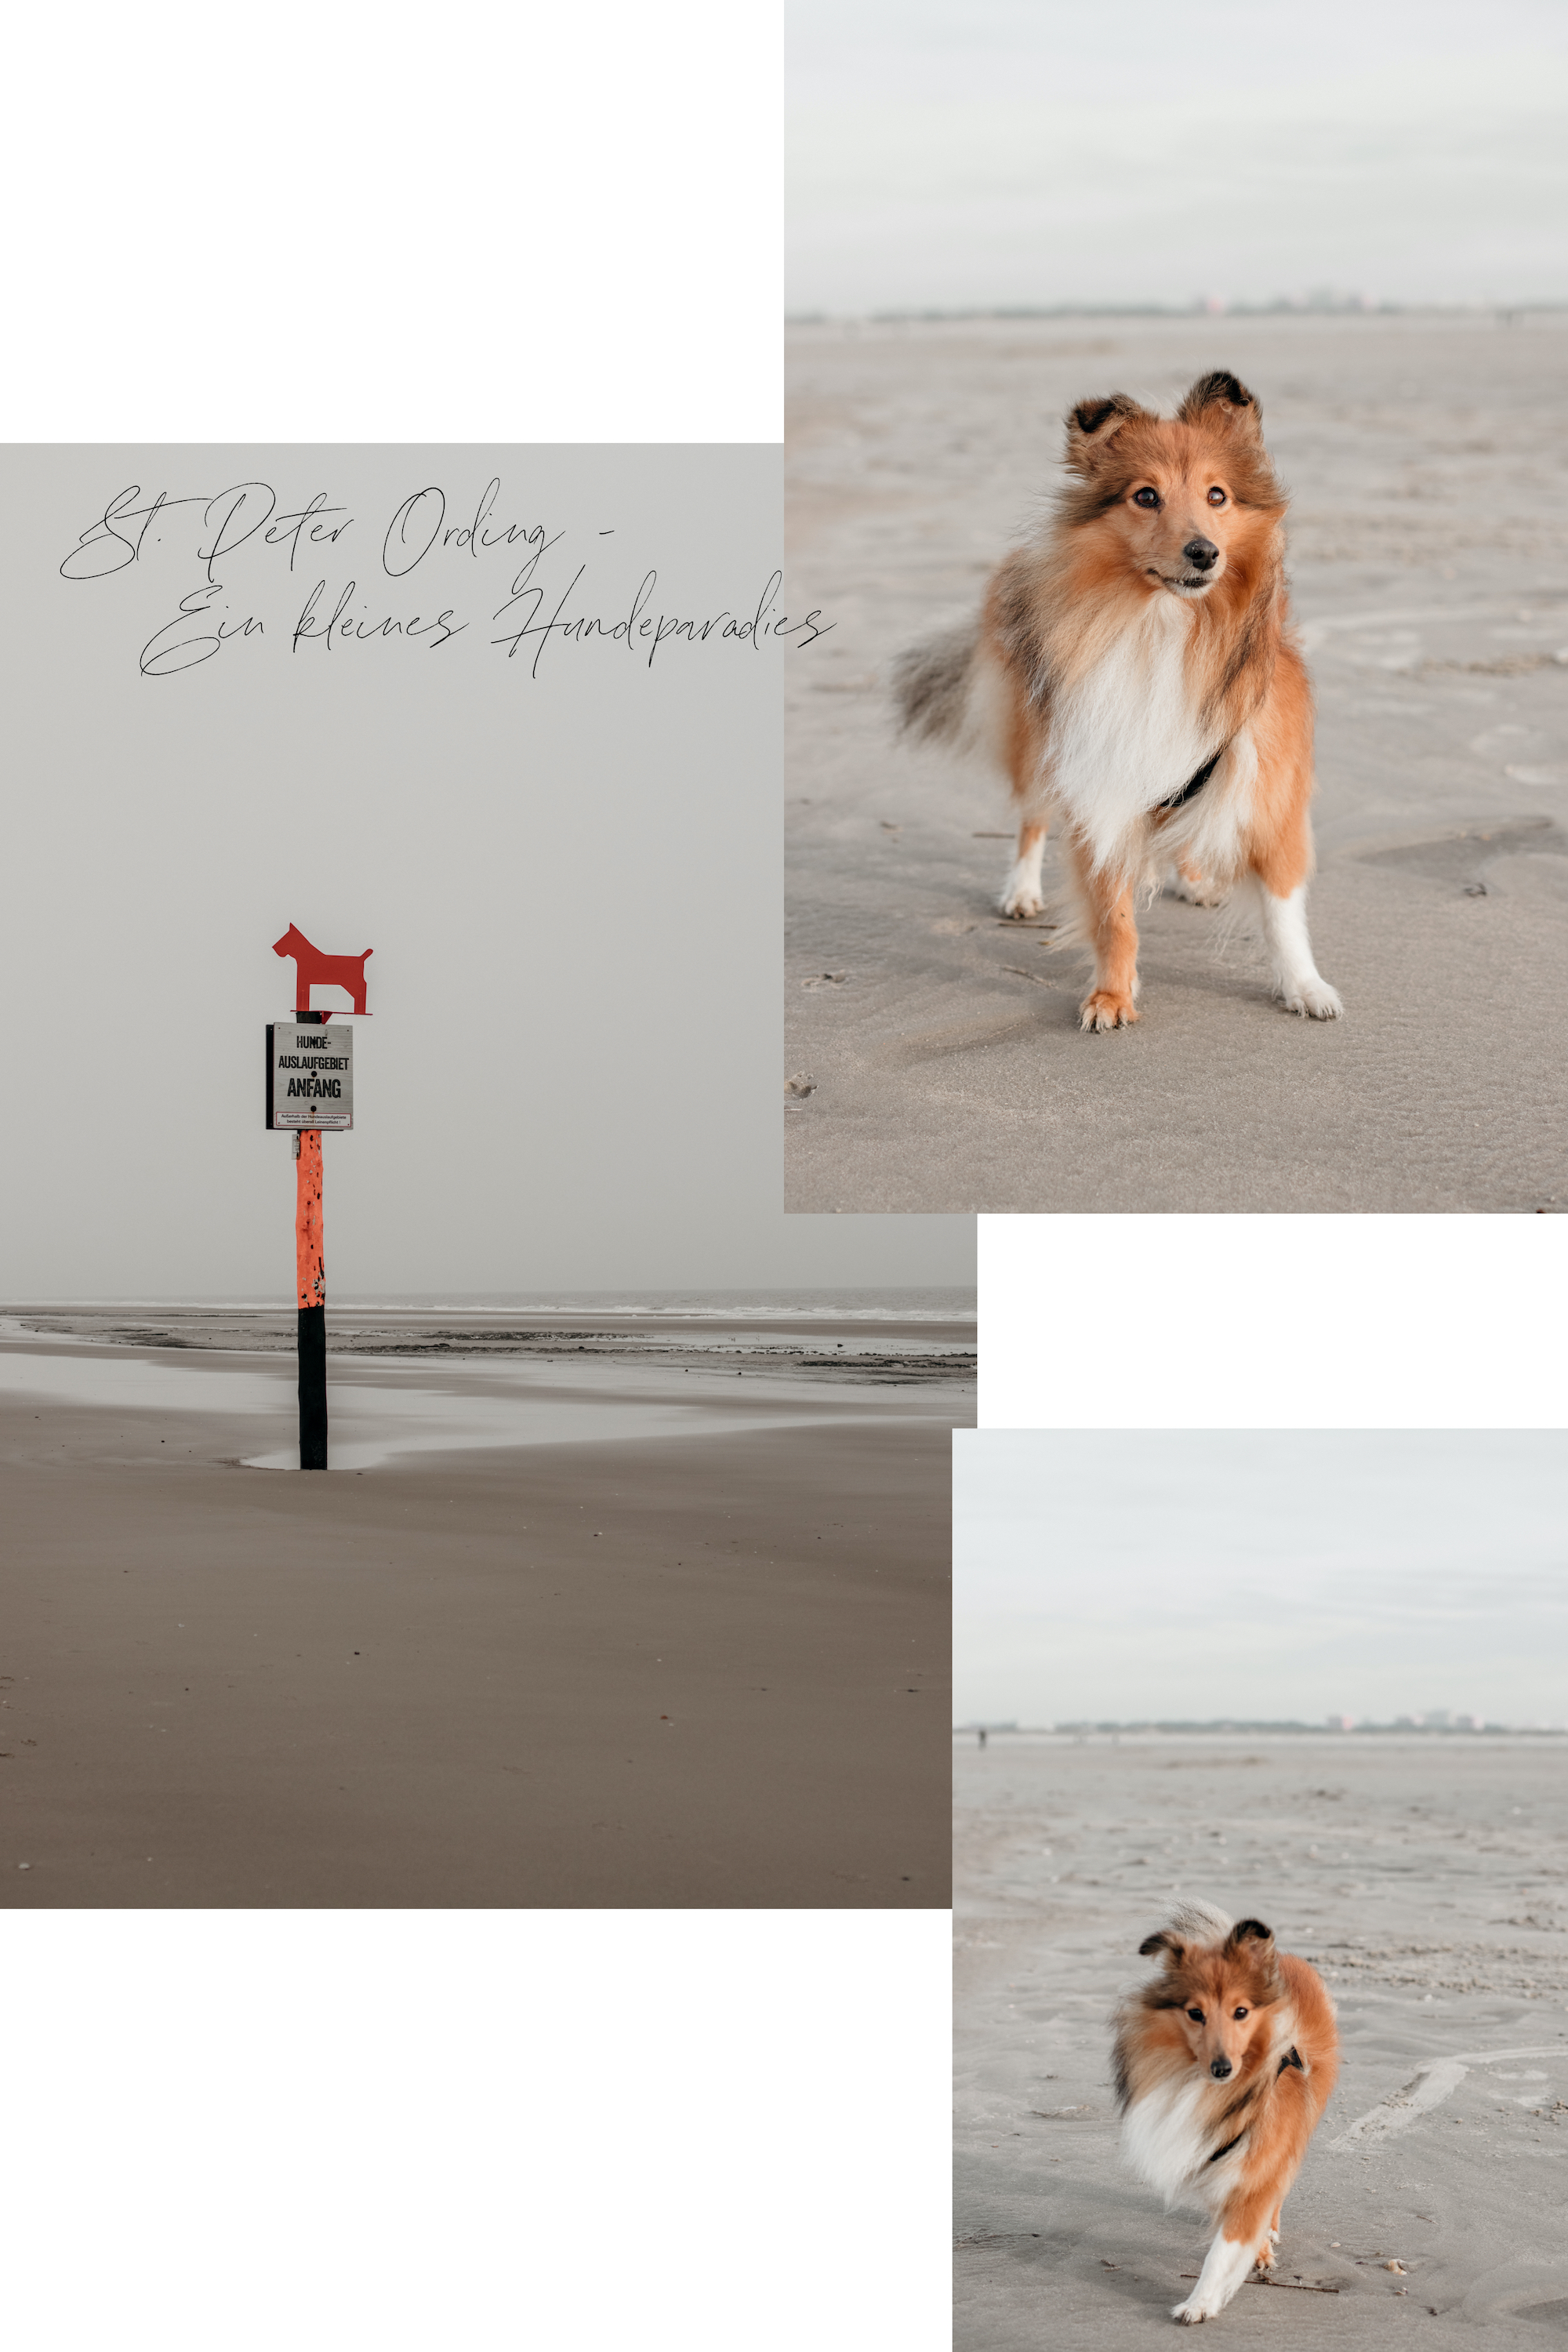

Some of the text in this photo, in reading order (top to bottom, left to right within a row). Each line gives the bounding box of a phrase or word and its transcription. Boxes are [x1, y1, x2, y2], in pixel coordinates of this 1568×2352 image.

[296, 1036, 332, 1049] HUNDE-
[278, 1055, 350, 1070] AUSLAUFGEBIET
[287, 1078, 341, 1098] ANFANG
